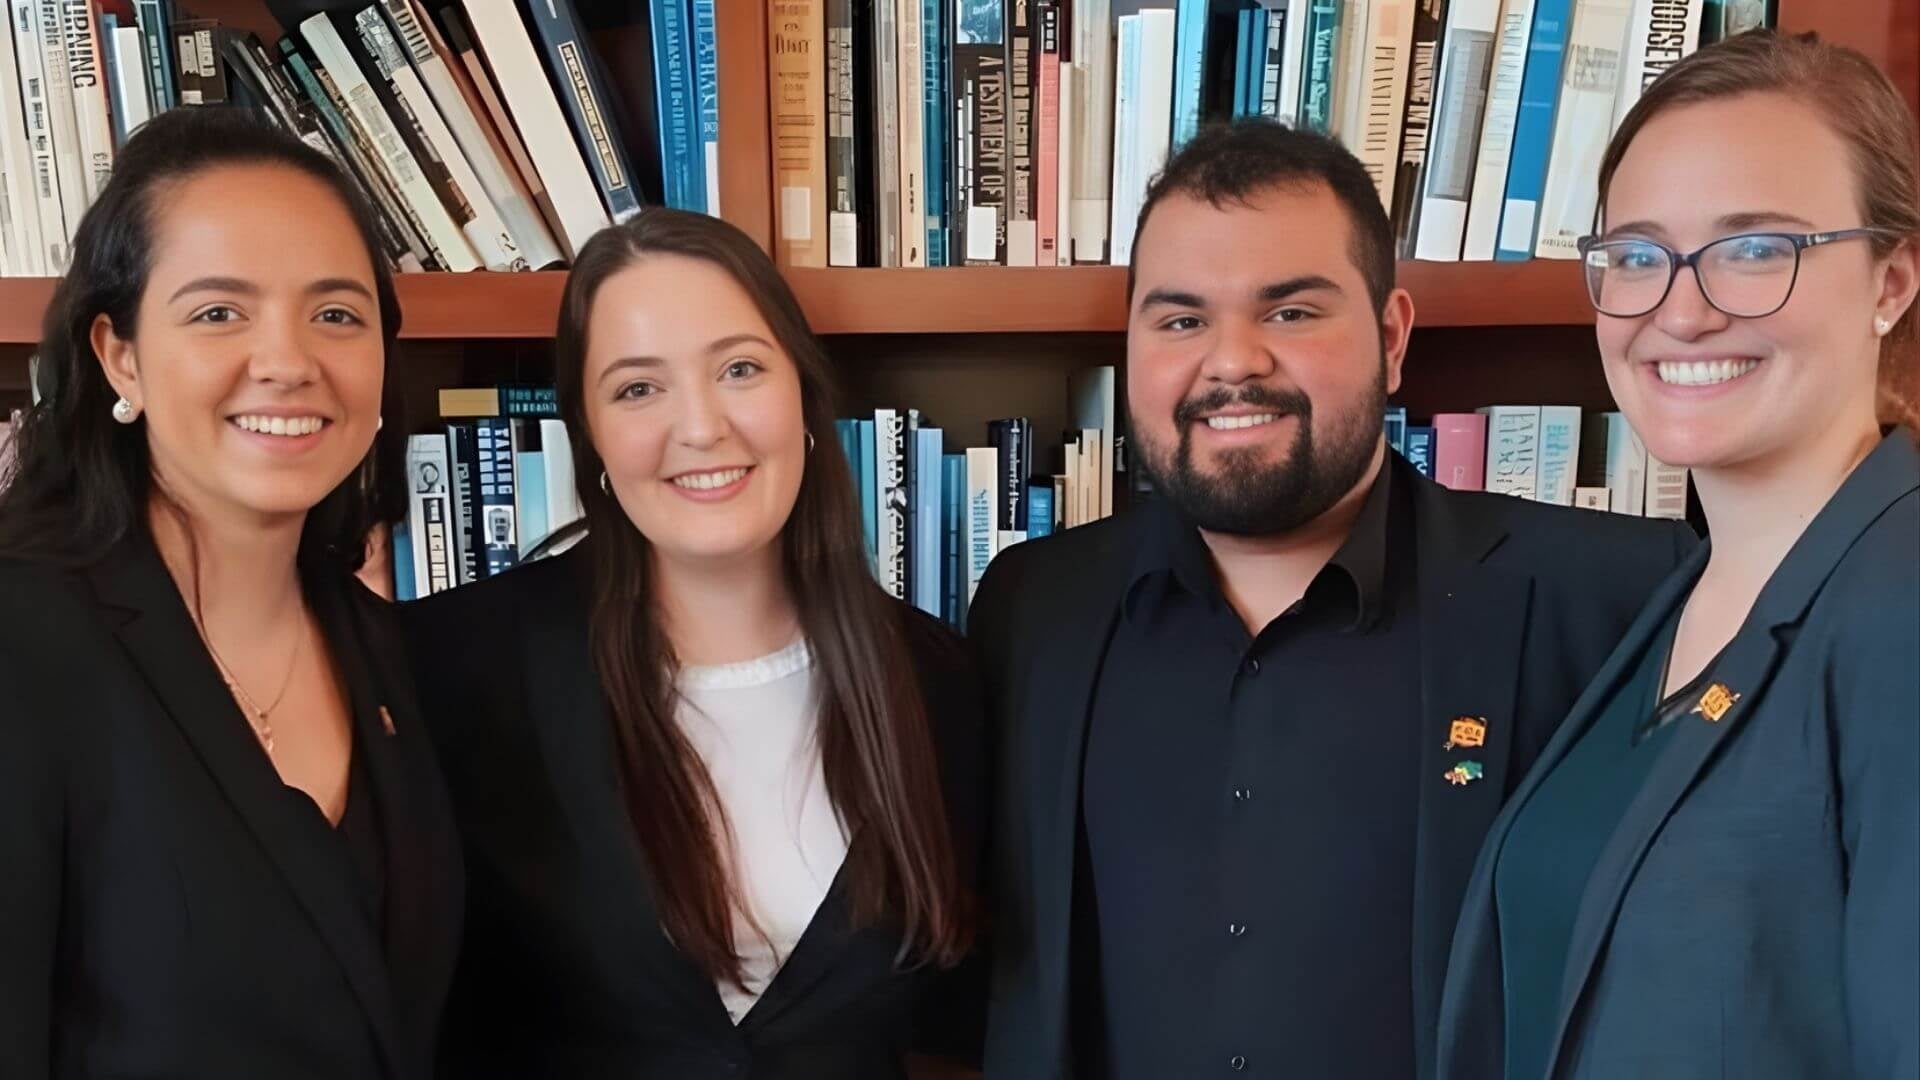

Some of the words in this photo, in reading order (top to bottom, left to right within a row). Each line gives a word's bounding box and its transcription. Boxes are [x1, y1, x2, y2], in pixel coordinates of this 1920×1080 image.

[979, 56, 1003, 67] A
[980, 72, 1005, 171] TESTAMENT
[980, 175, 1005, 196] OF
[887, 416, 903, 485] DEAD
